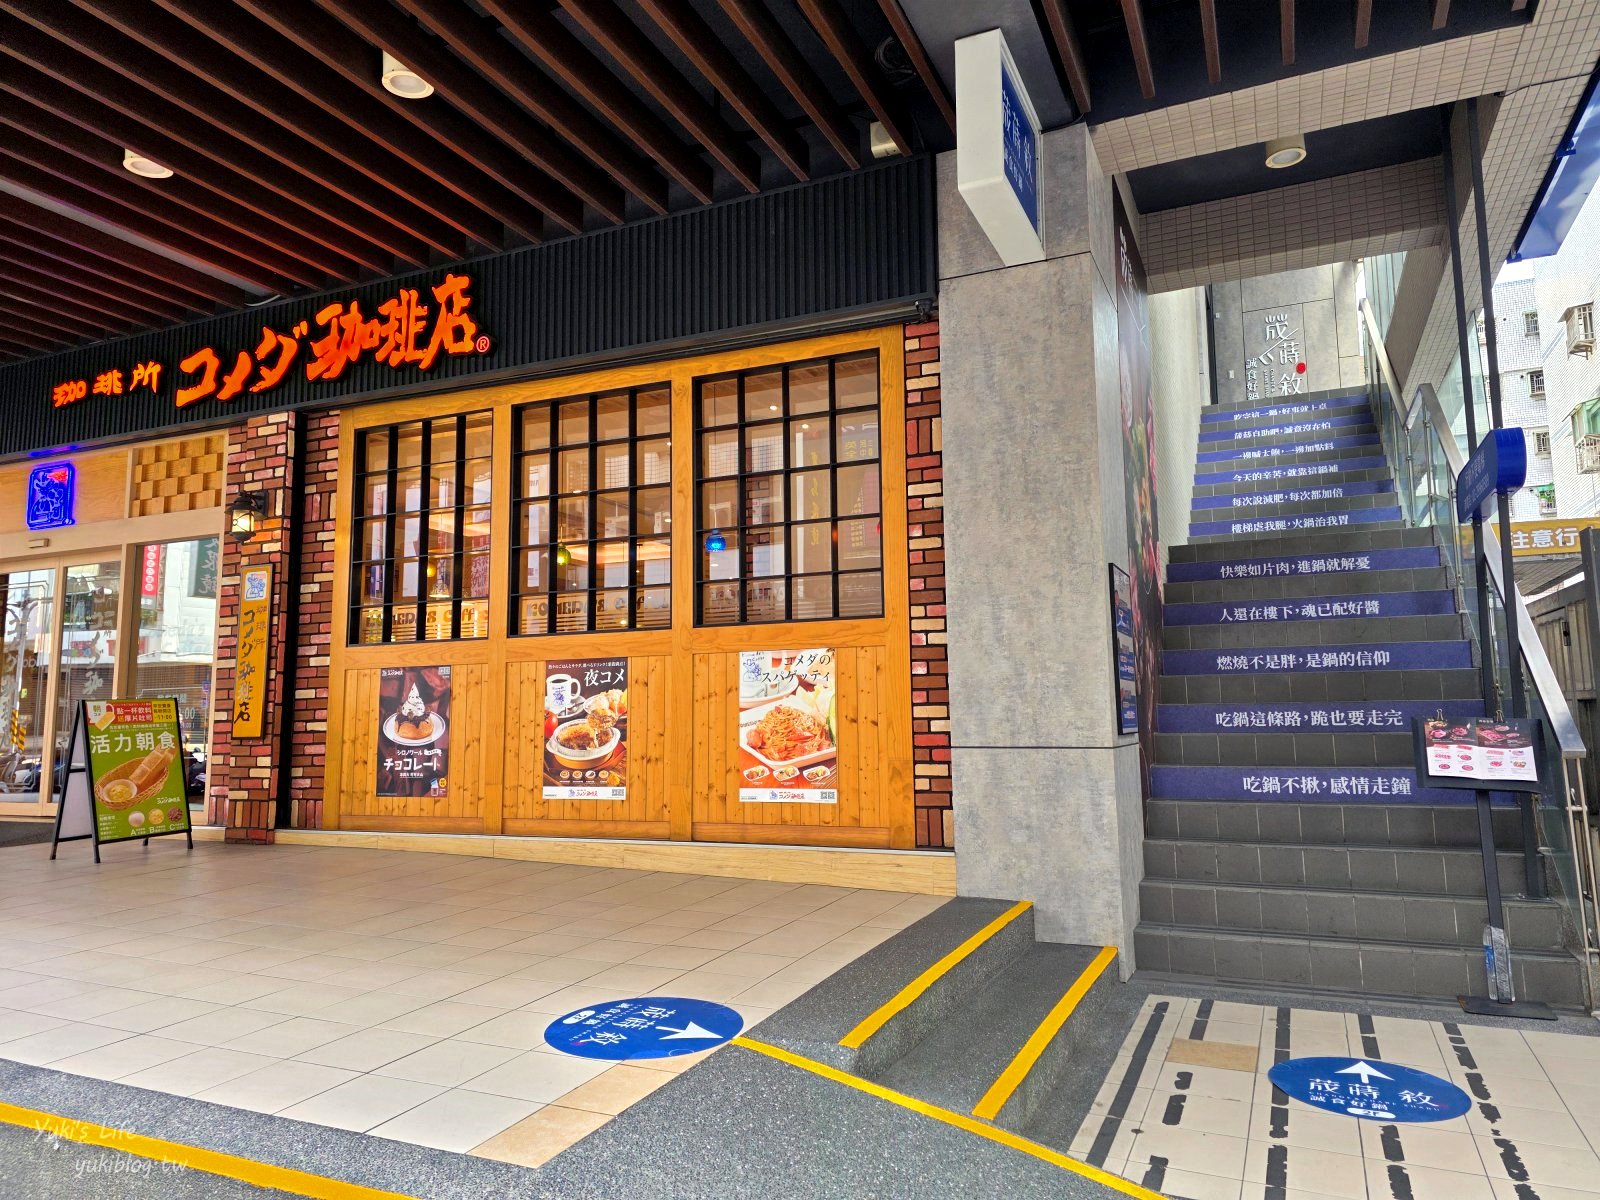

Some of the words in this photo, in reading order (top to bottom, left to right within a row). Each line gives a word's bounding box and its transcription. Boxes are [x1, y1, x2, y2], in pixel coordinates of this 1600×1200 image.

[784, 653, 832, 667] コメダの
[584, 668, 625, 687] 夜コメ
[762, 669, 830, 683] スパゲッティ
[90, 731, 176, 754] 活力朝食
[383, 757, 441, 771] チョコレート
